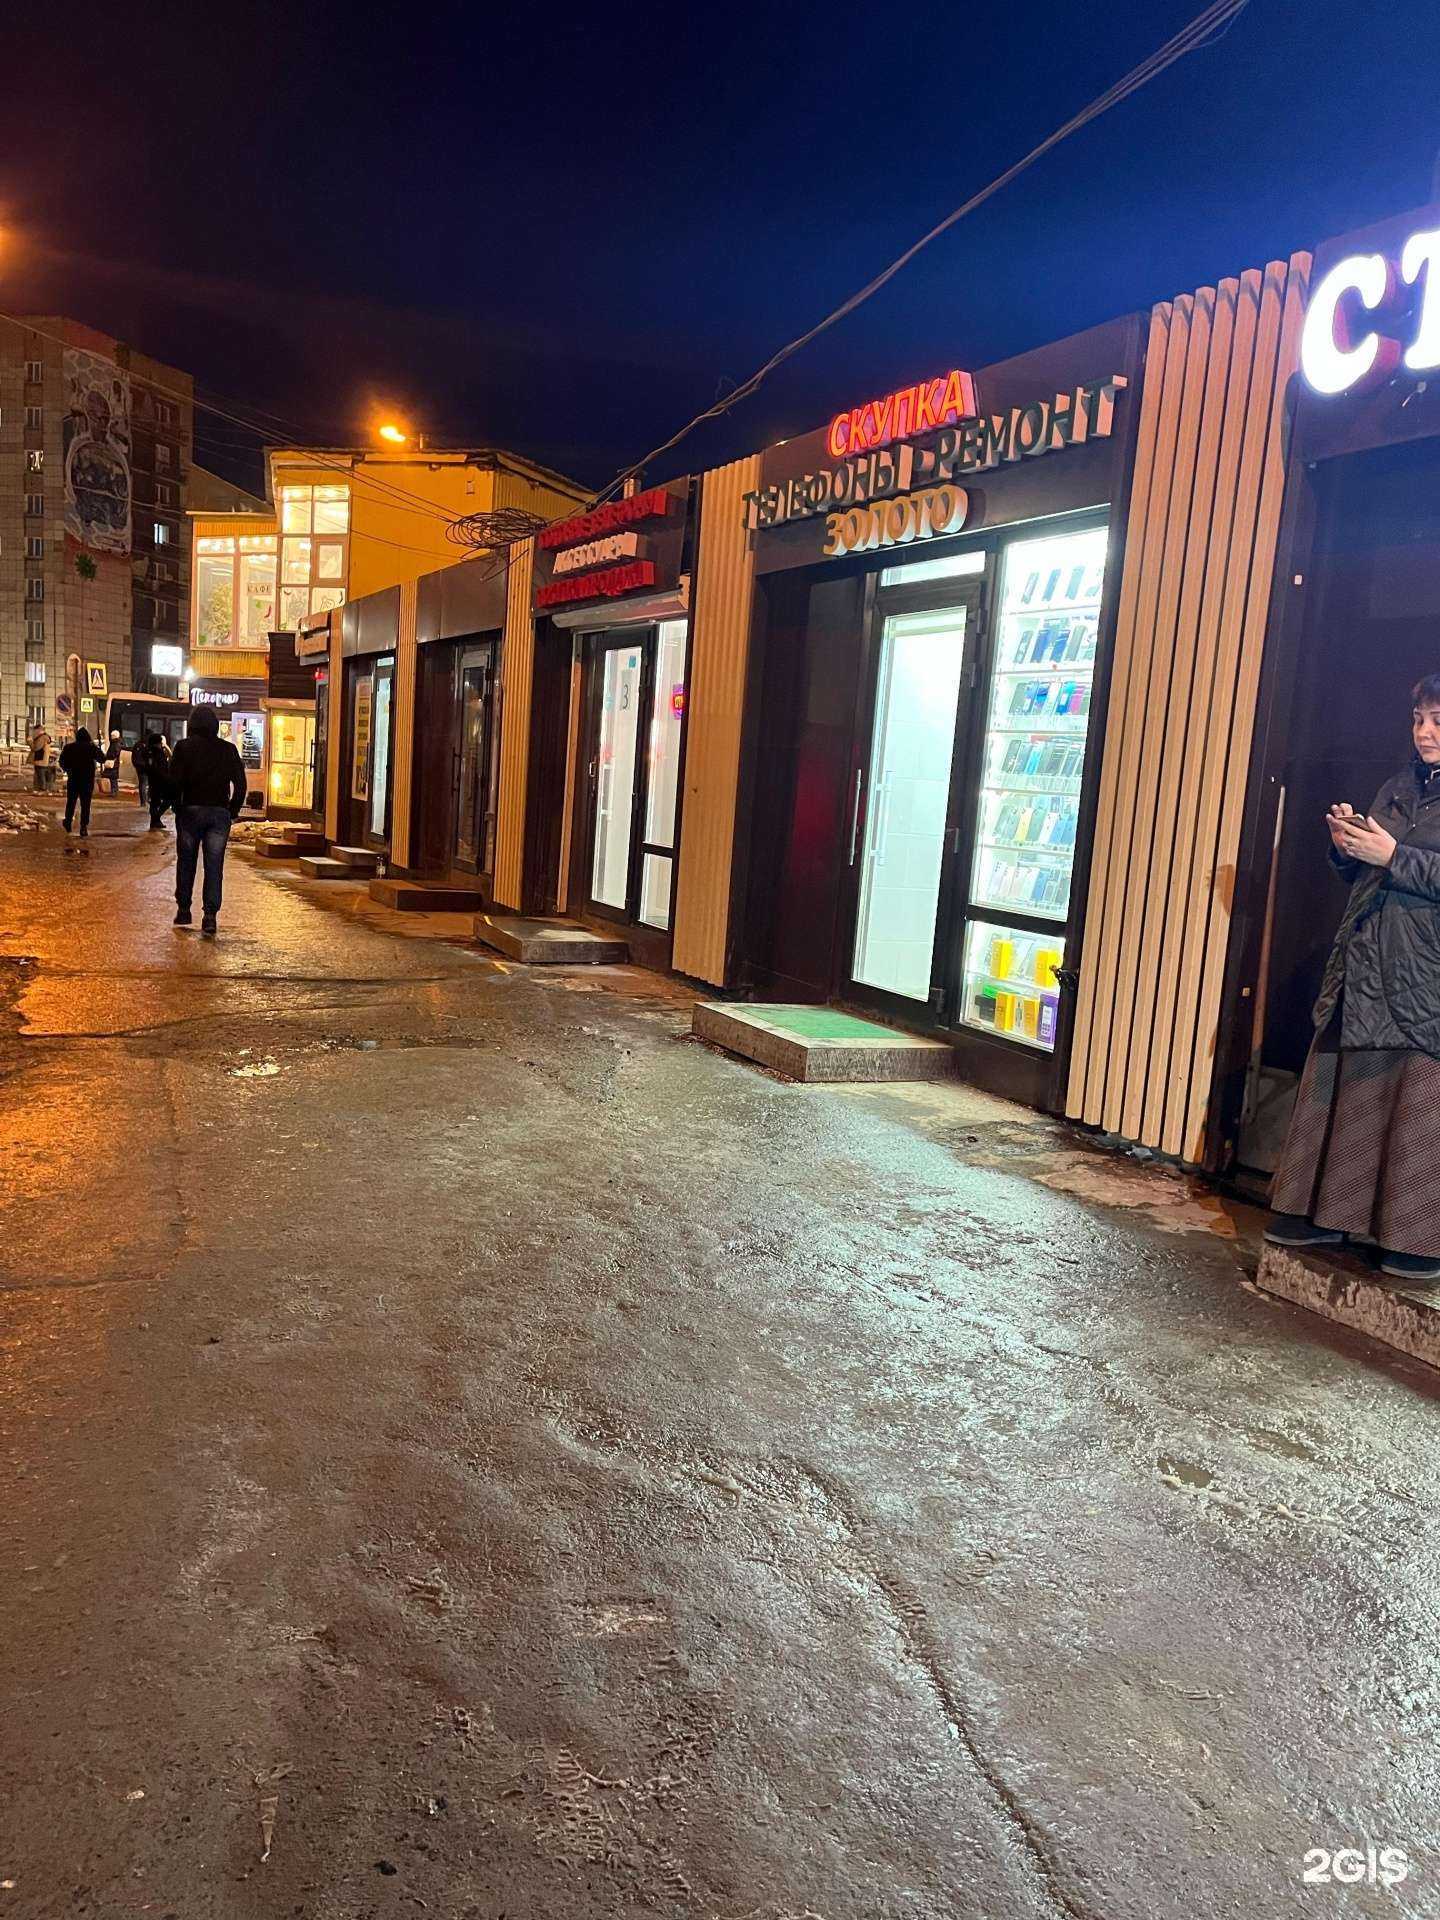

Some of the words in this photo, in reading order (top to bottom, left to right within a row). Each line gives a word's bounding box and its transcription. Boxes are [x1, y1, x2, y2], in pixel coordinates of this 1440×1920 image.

[743, 443, 914, 531] ТЕЛЕФОНЫ
[937, 375, 1128, 480] РЕМОНТ
[828, 370, 973, 458] СКУПКА
[823, 484, 968, 556] ЗОЛОТО
